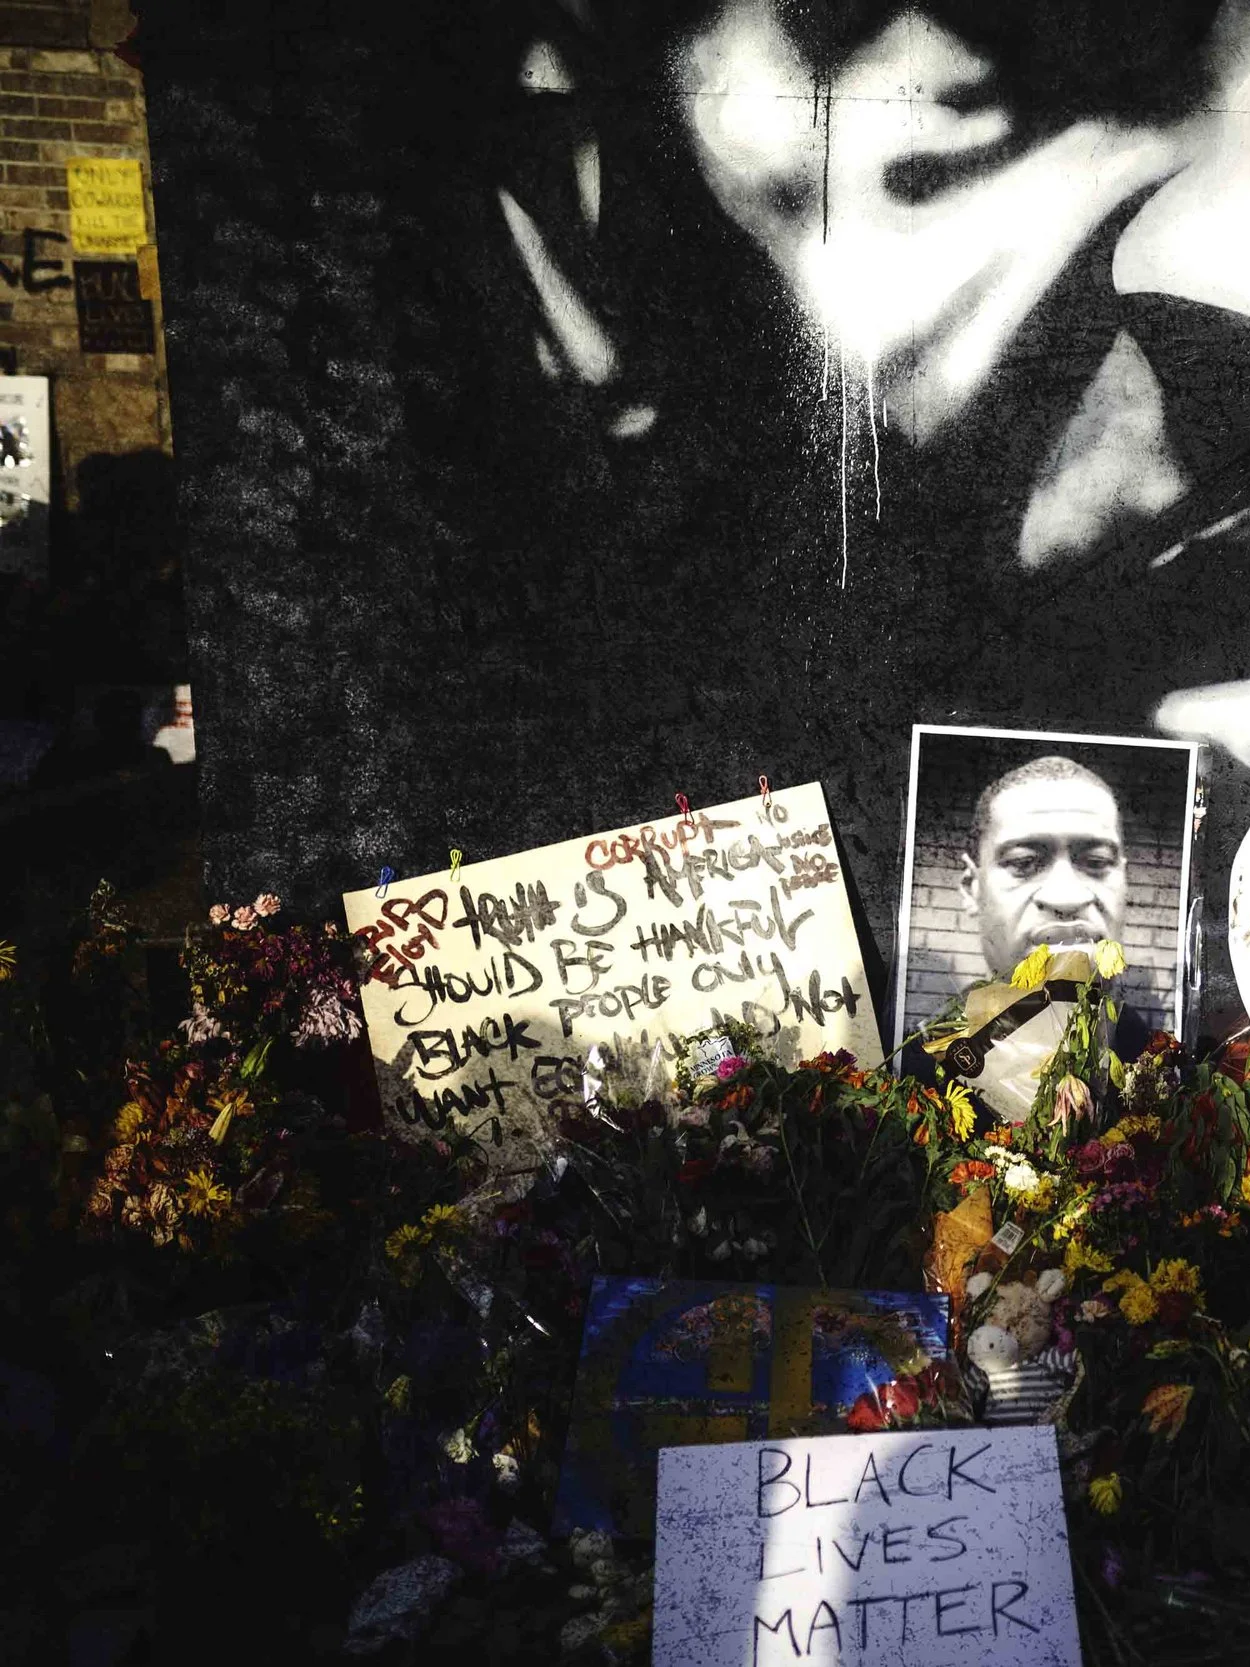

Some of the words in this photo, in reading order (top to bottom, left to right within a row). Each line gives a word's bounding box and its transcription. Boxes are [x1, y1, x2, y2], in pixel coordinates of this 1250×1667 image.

[571, 870, 627, 936] IS
[550, 938, 615, 994] BE
[407, 1014, 541, 1080] BLACK
[758, 1444, 997, 1518] BLACK
[759, 1516, 968, 1582] LIVES
[753, 1580, 1041, 1667] MATTER
